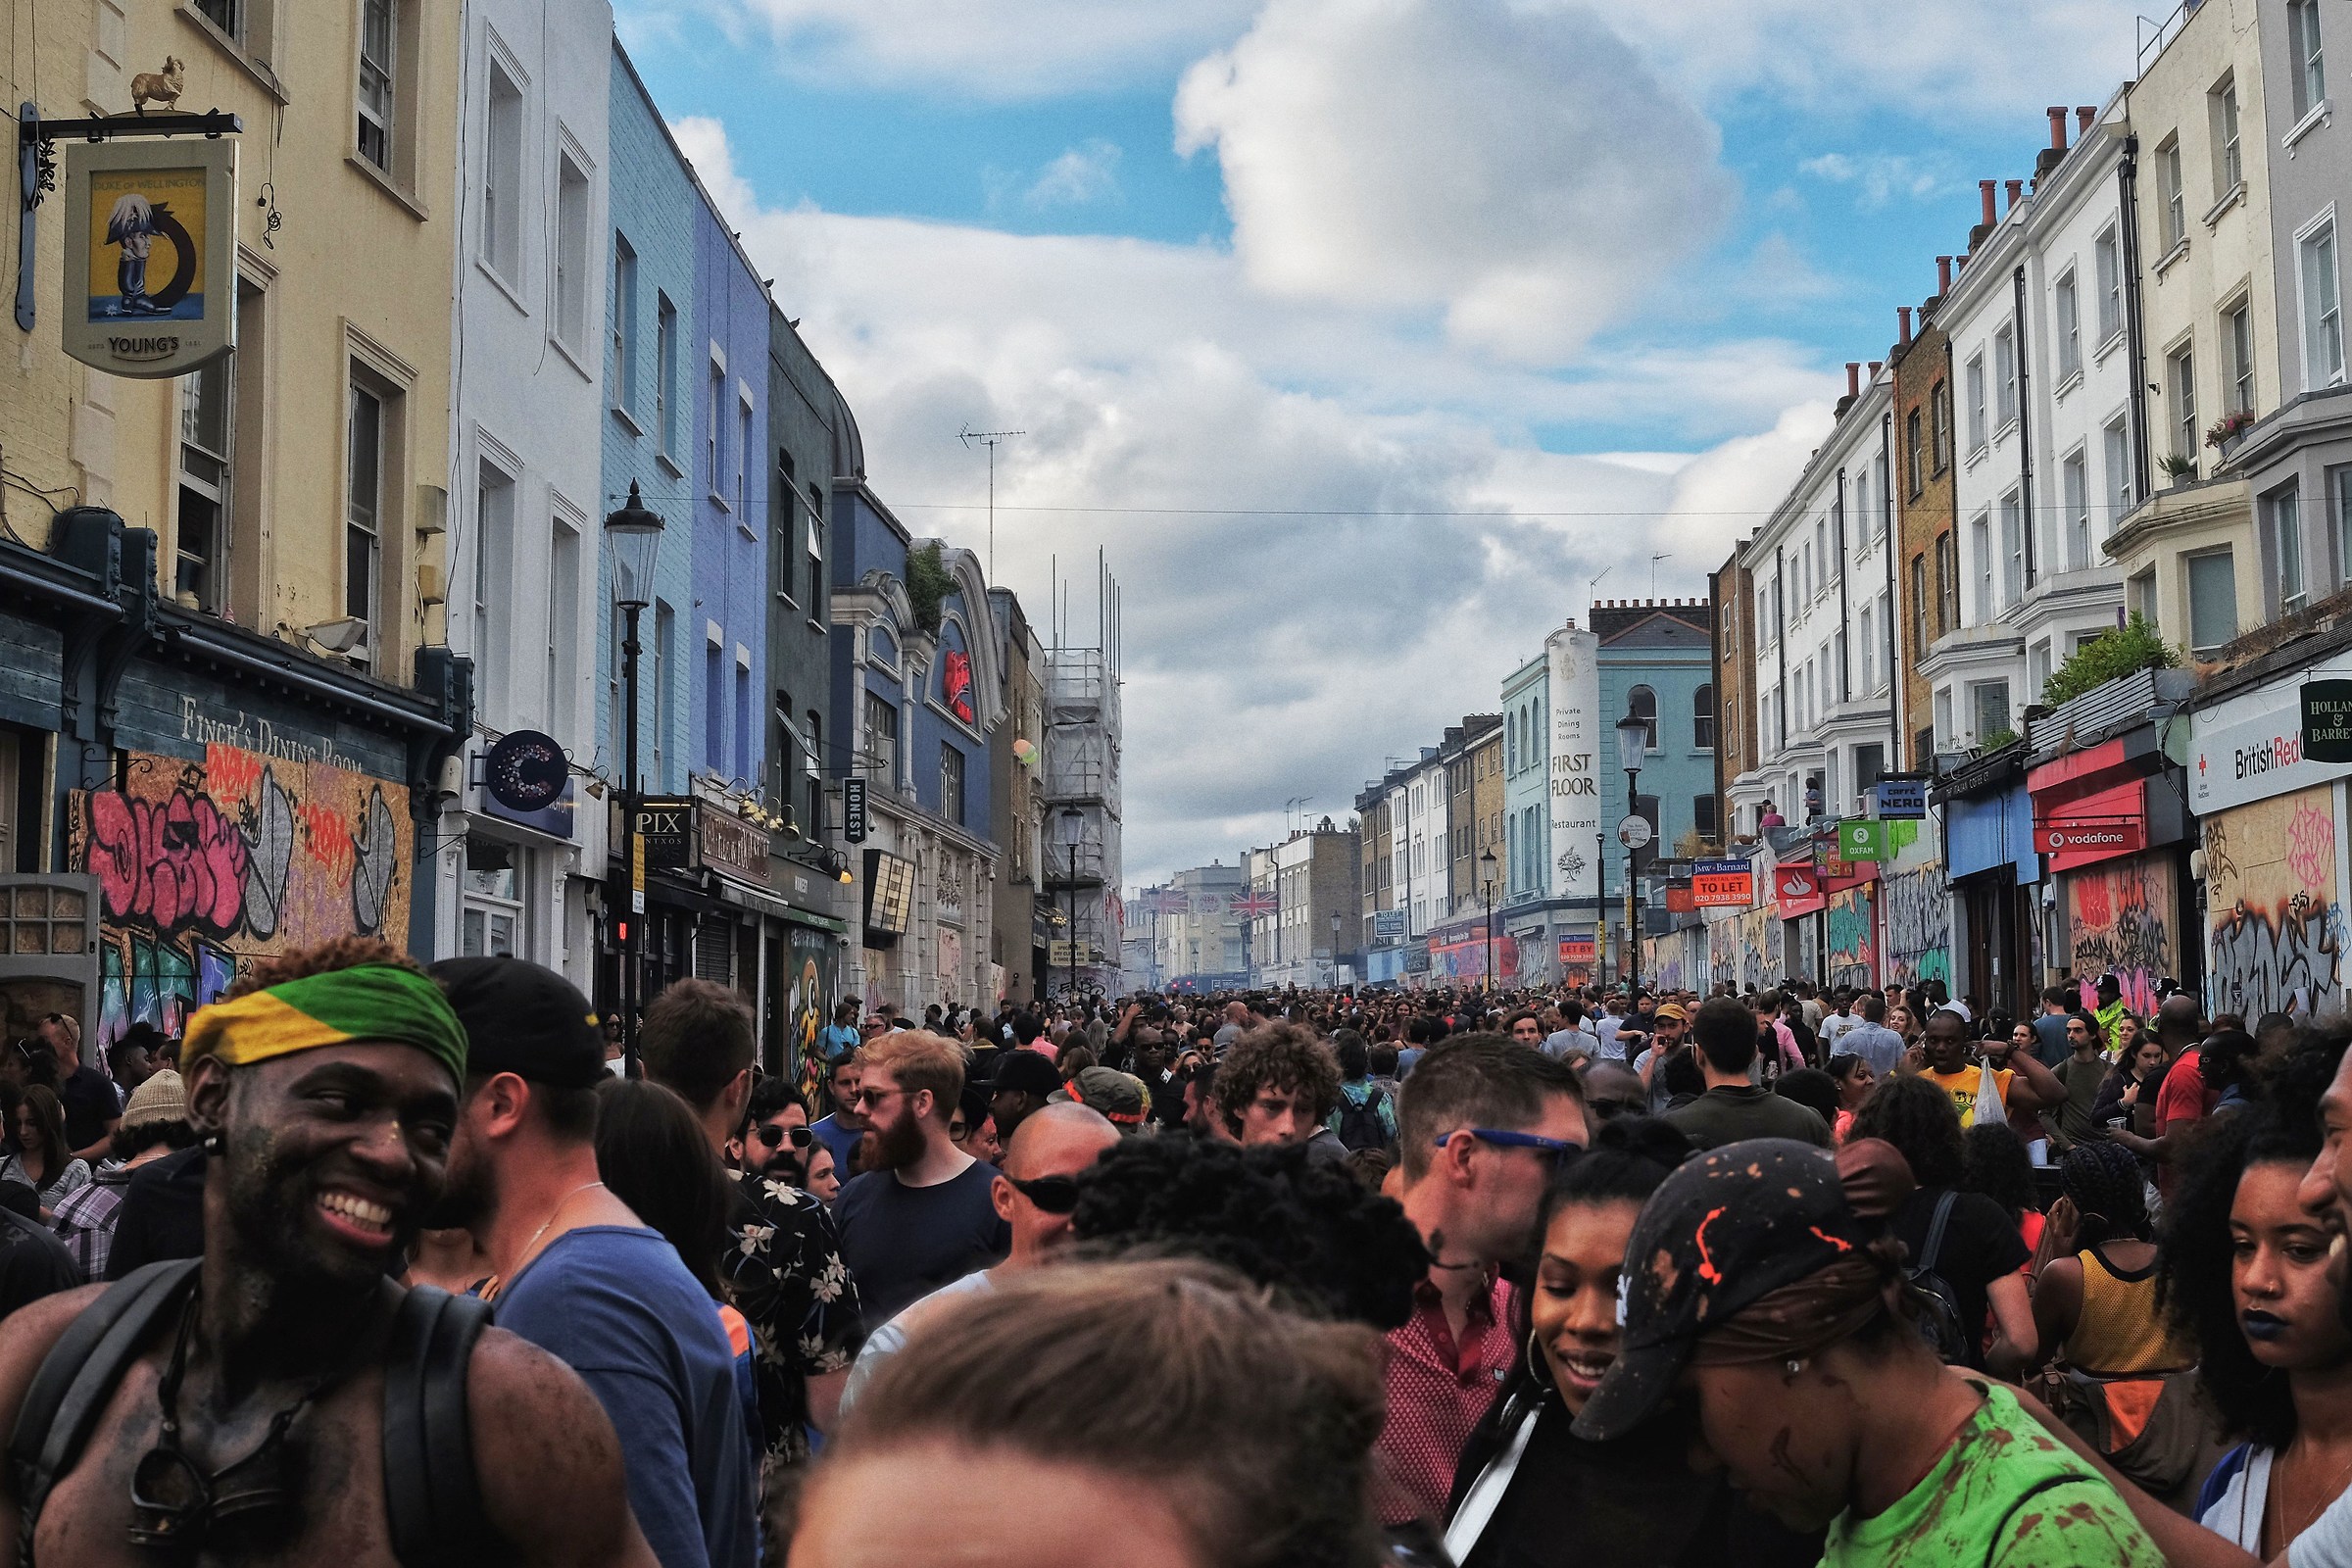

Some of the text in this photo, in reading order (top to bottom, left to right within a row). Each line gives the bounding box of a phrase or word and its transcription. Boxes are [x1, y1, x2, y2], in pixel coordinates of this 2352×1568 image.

[93, 180, 122, 191] DUKE
[137, 178, 205, 189] WELLINGTON
[109, 336, 179, 354] YOUNG'S
[1556, 708, 1581, 716] Private
[1557, 719, 1580, 728] Dining
[2332, 712, 2344, 727] &
[1551, 753, 1592, 774] FIRST
[1551, 777, 1597, 798] FLOOR
[1881, 798, 1924, 808] NERO
[849, 784, 861, 837] HONEST
[636, 812, 681, 833] PIX
[1551, 819, 1596, 829] Restaurant
[2067, 832, 2124, 844] vodafone
[1716, 861, 1749, 872] Barnard
[1700, 882, 1743, 893] TO LET
